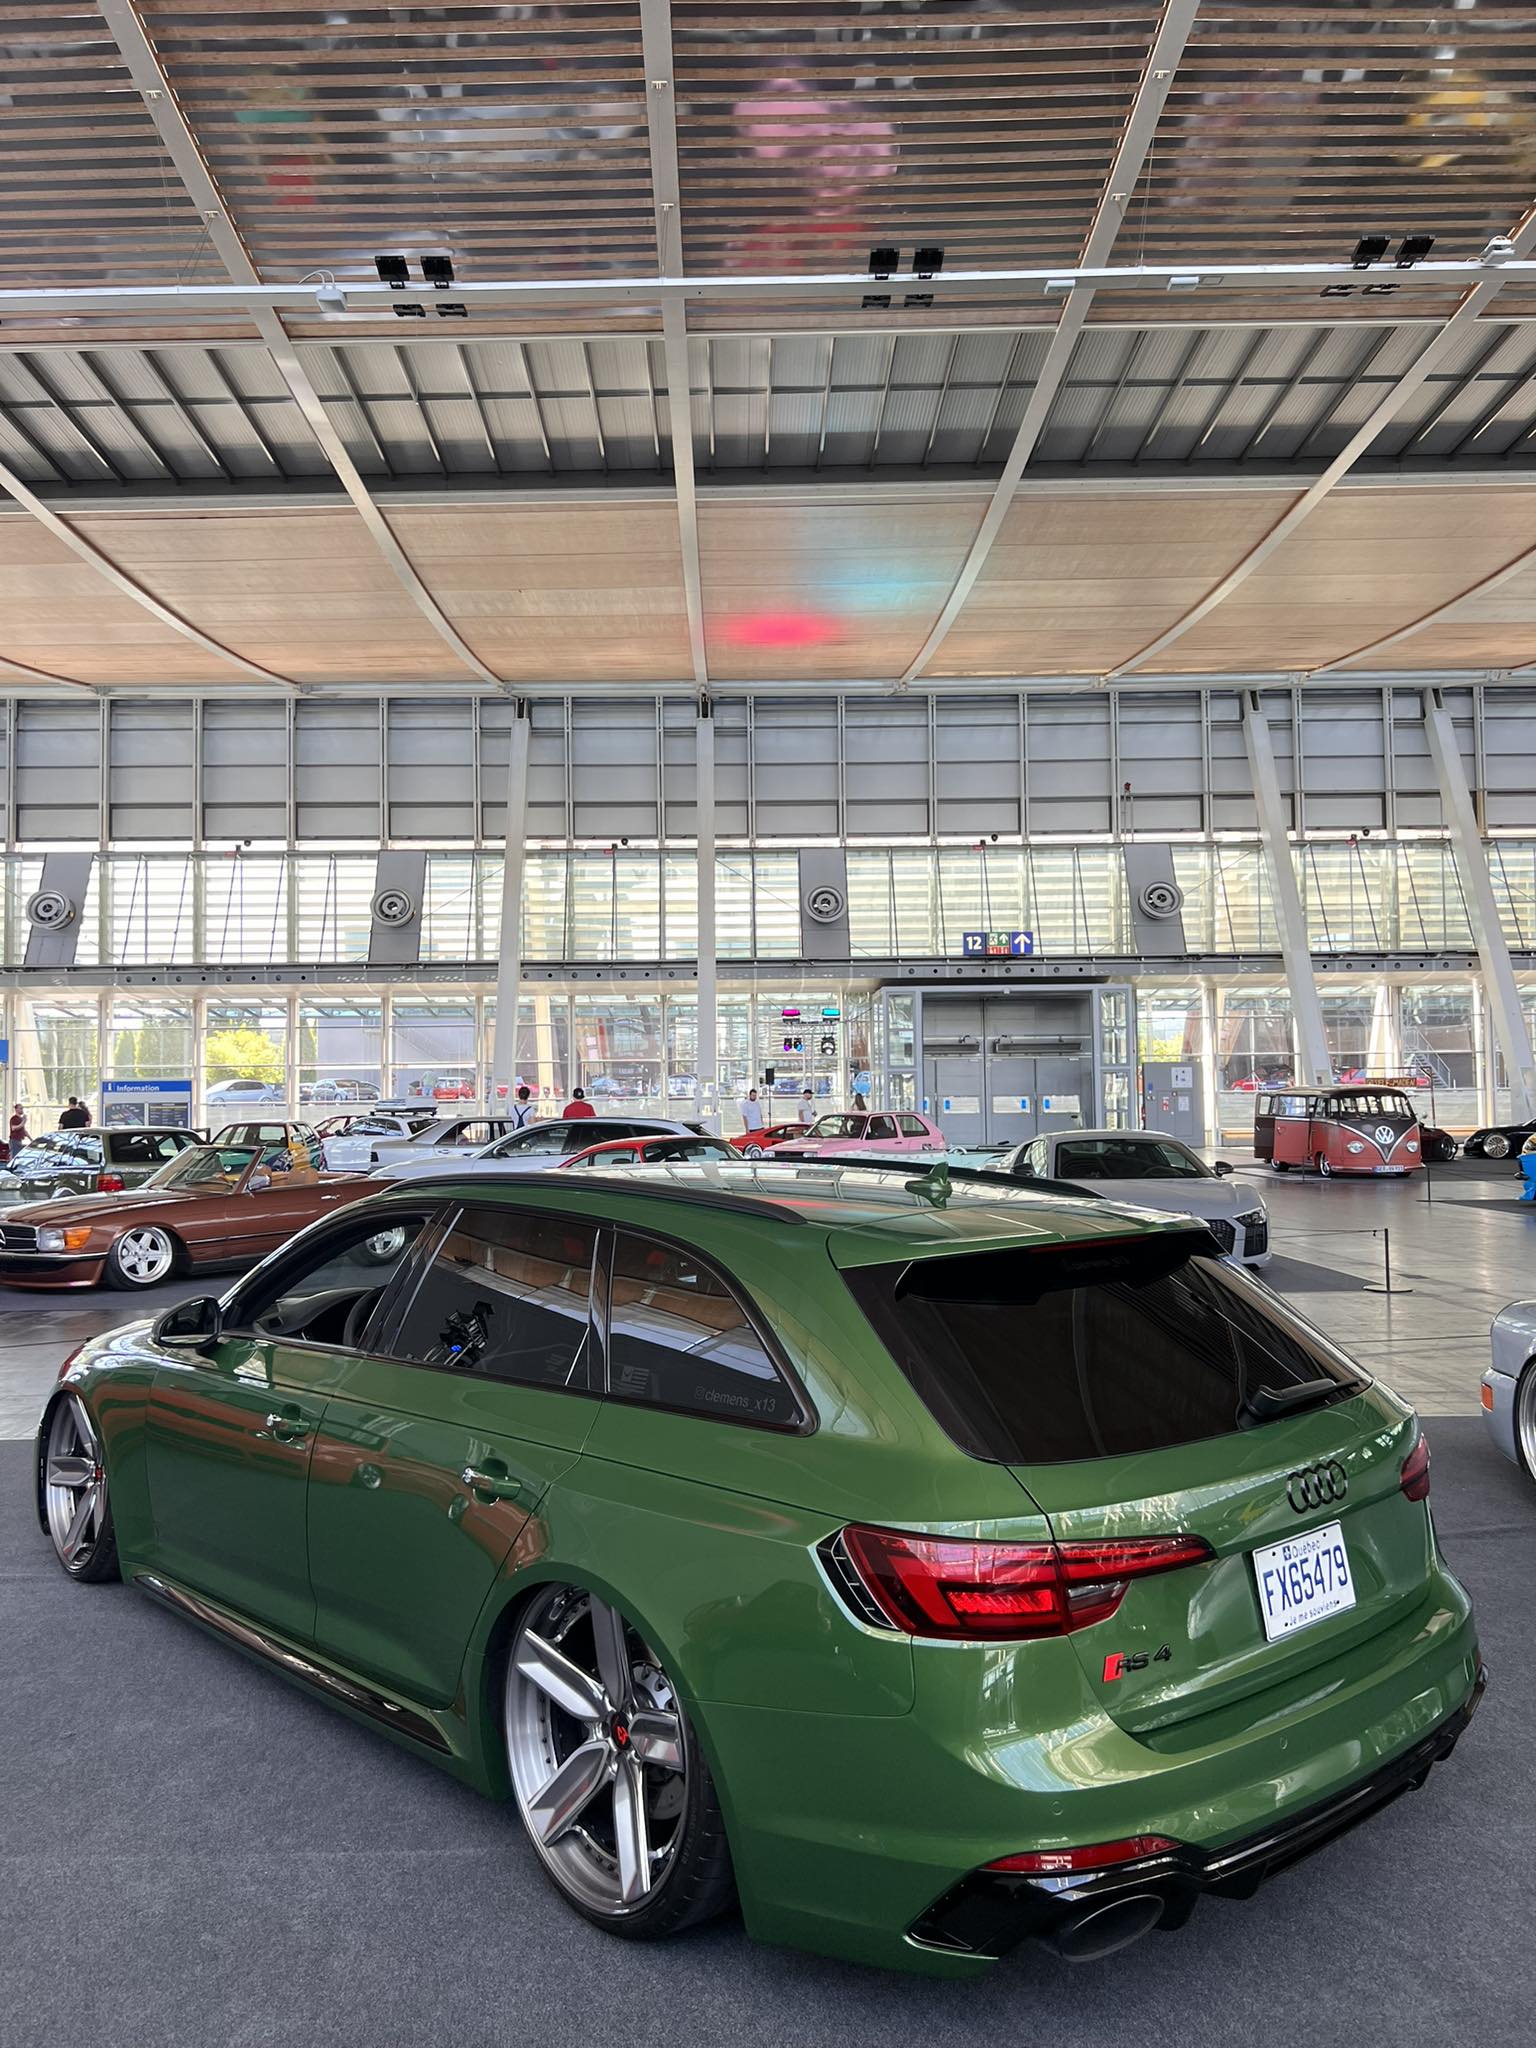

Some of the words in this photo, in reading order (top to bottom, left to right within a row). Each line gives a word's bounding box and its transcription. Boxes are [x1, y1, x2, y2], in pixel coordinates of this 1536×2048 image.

[966, 936, 982, 950] 12
[117, 1084, 160, 1092] Information
[1375, 1126, 1394, 1144] VW
[695, 1386, 776, 1413] @clemens_x13
[1262, 1545, 1348, 1616] FX65479
[1114, 1651, 1149, 1676] RS
[1153, 1642, 1172, 1661] 4
